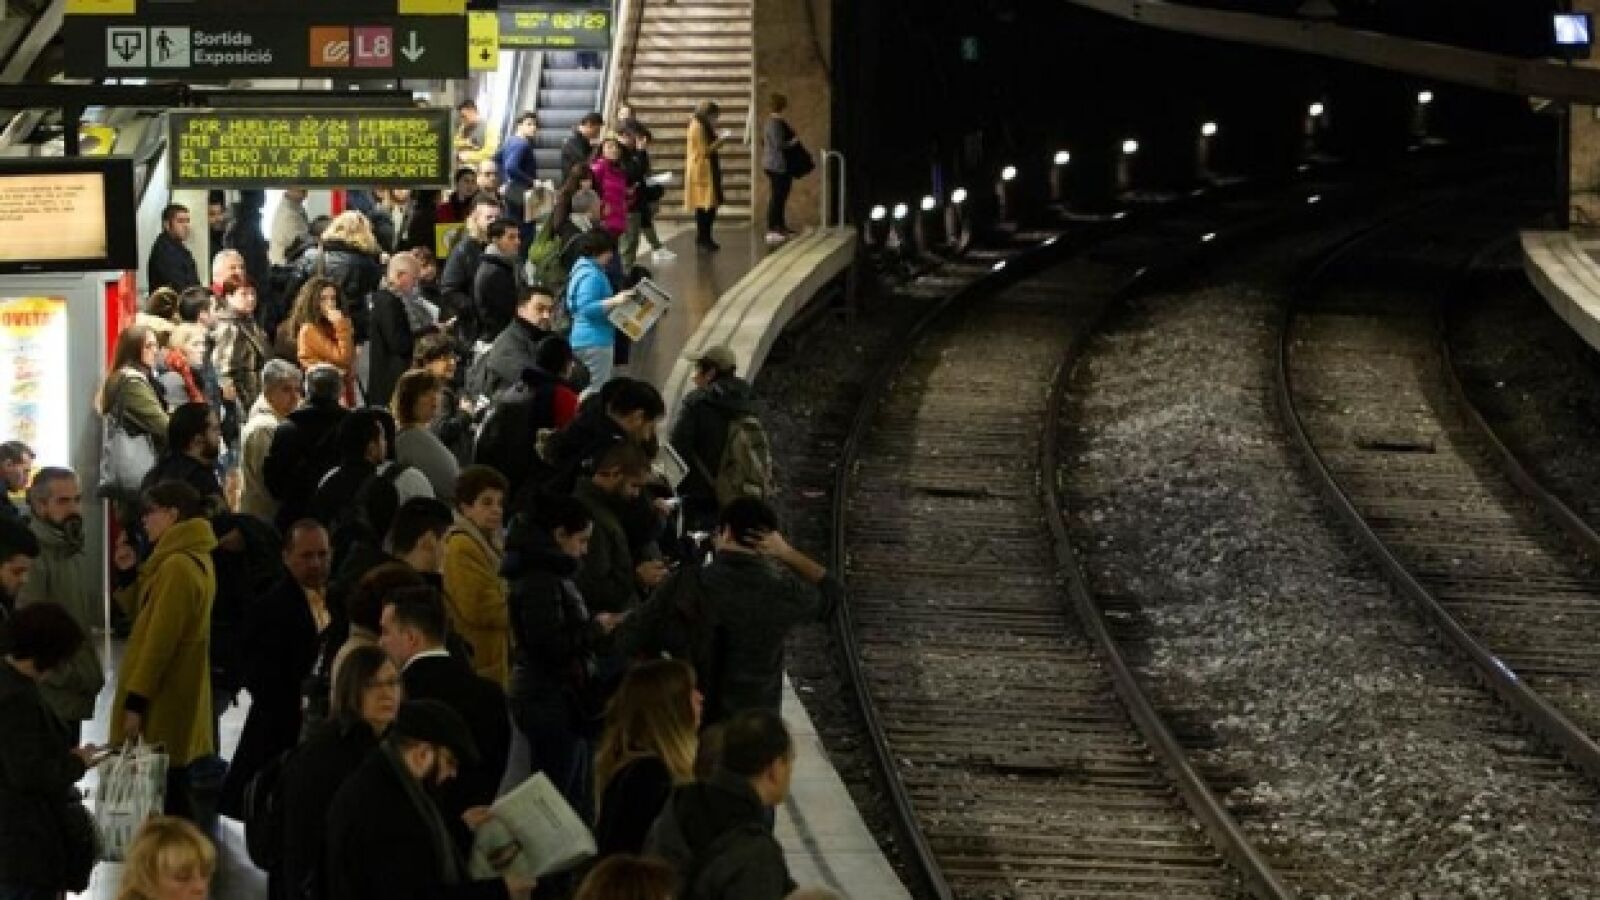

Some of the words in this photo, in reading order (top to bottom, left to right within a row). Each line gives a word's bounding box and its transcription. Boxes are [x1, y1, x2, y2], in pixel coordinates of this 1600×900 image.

[194, 31, 252, 46] Sortida
[357, 36, 390, 57] L8
[194, 48, 273, 66] Exposició
[189, 119, 220, 132] POR
[229, 119, 290, 132] HUELGA
[358, 119, 428, 132] FEBRERO
[220, 135, 318, 147] RECOMIENDA
[328, 135, 349, 147] NO
[358, 134, 438, 147] UTILIZAR
[180, 148, 201, 162] EL
[209, 148, 260, 162] METRO
[268, 148, 280, 162] Y
[289, 148, 339, 162] OPTAR
[348, 148, 378, 162] POR
[386, 148, 438, 162] OTRAS
[180, 163, 300, 177] ALTERNATIVAS
[309, 163, 329, 177] DE
[339, 163, 438, 177] TRANSPORTE
